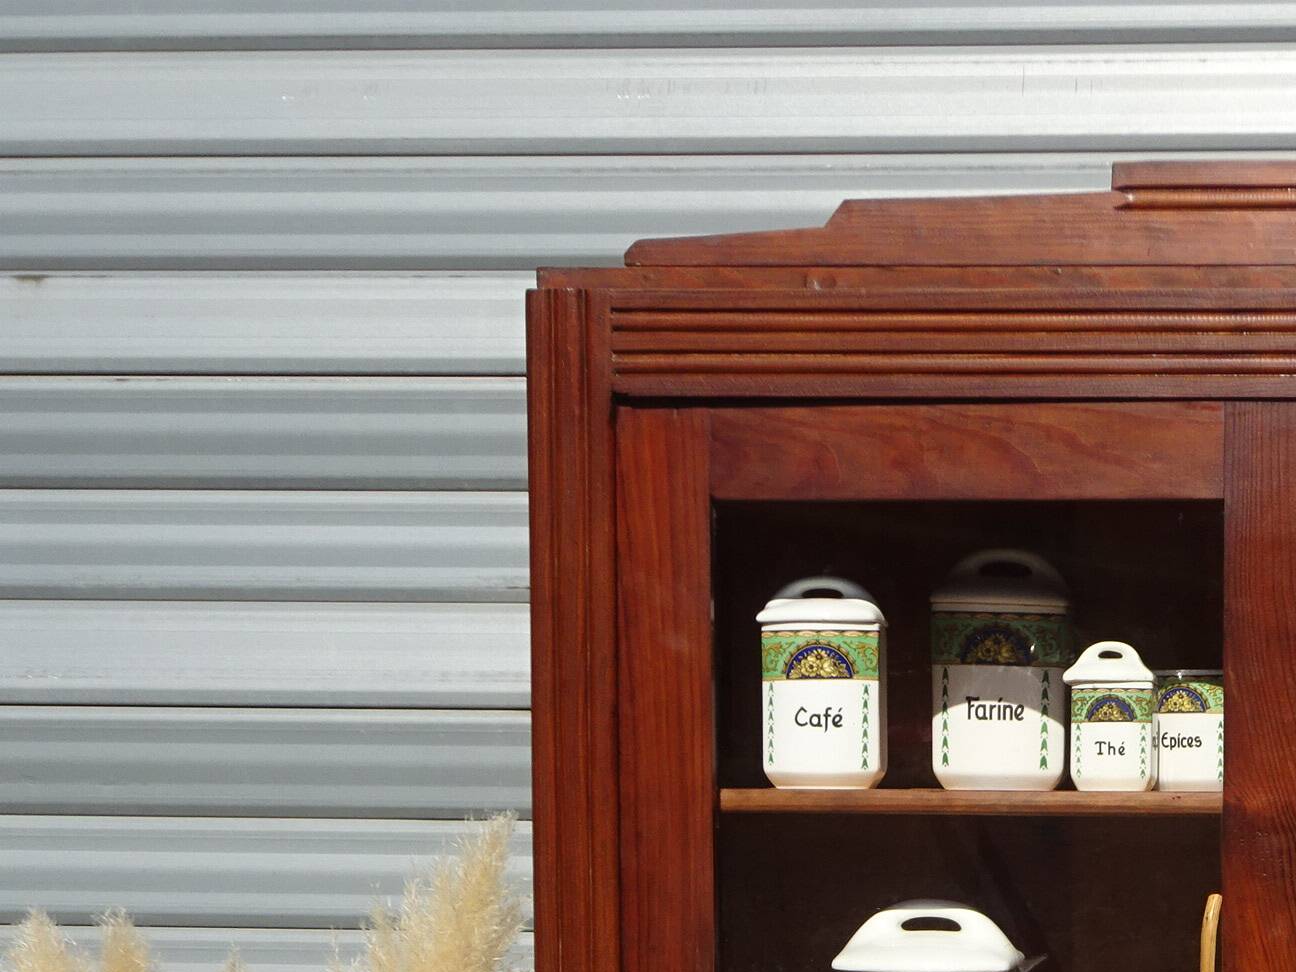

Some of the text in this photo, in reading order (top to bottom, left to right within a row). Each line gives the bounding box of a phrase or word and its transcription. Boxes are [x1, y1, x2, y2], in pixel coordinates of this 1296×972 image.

[795, 706, 843, 733] Café
[965, 696, 1025, 721] Farine
[1094, 741, 1126, 756] Thé
[1161, 731, 1203, 750] Epices
